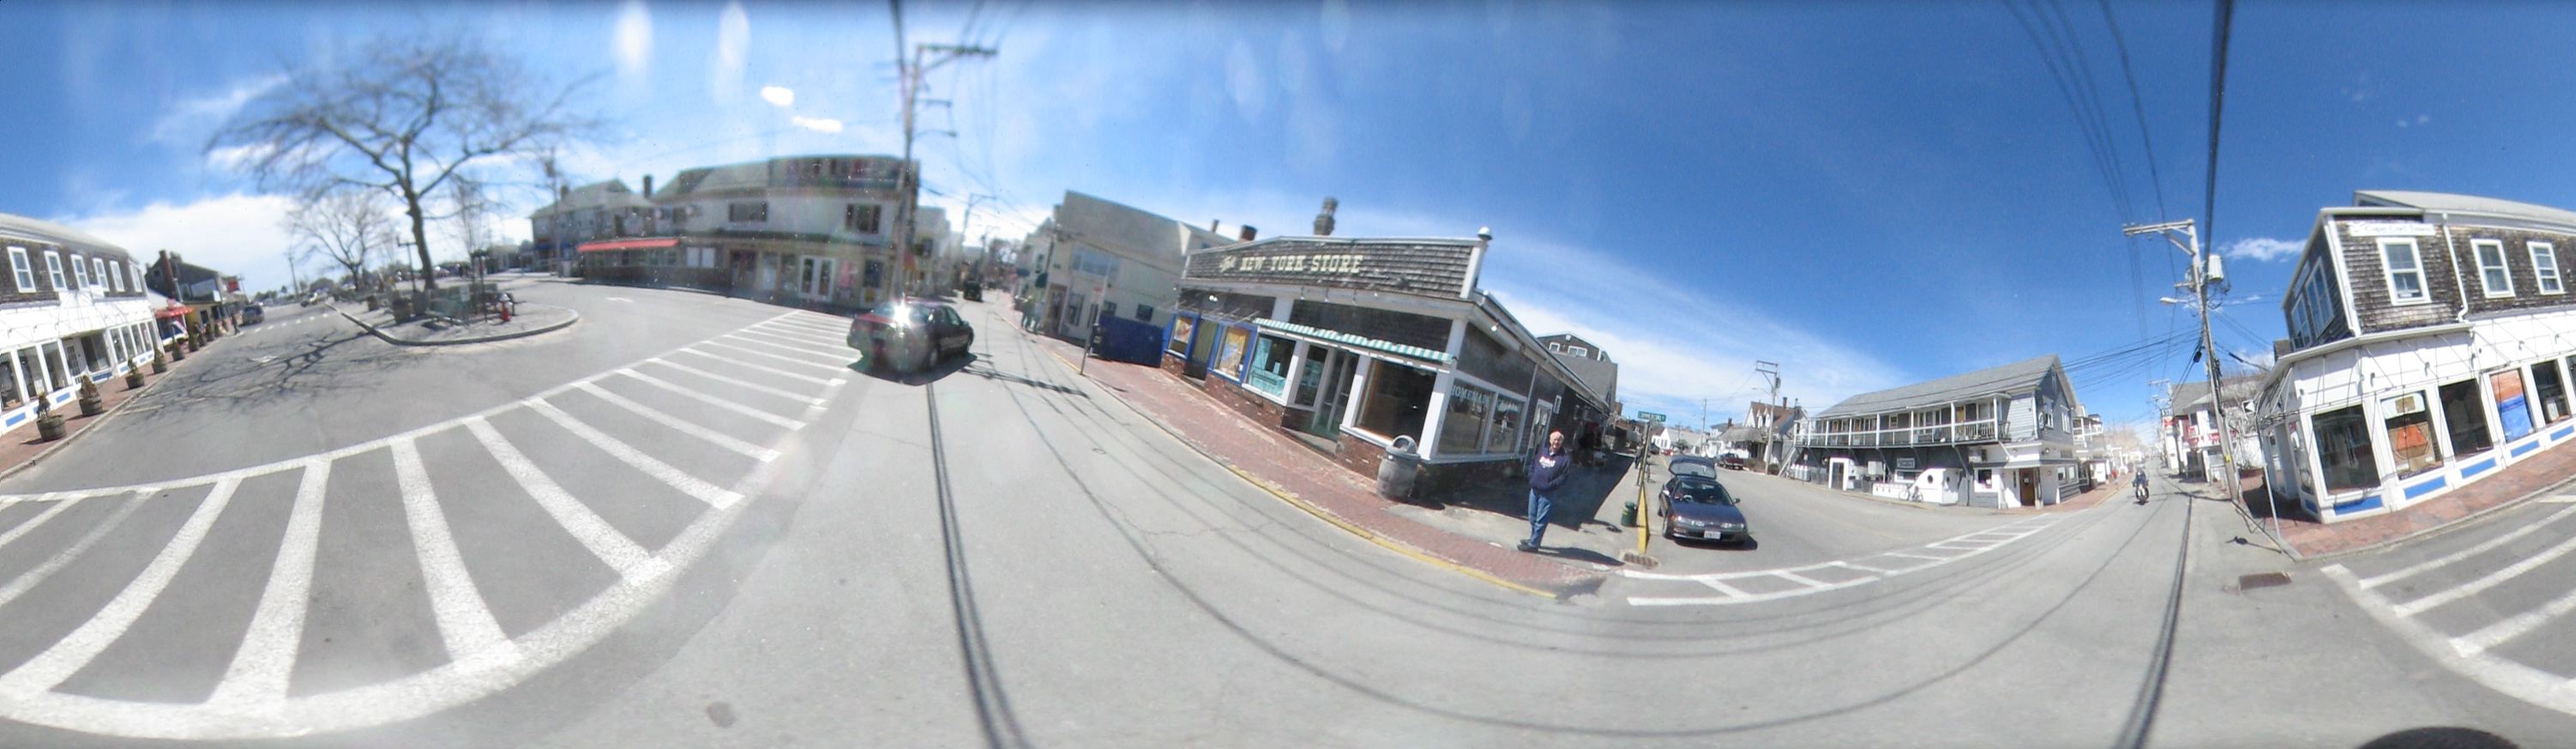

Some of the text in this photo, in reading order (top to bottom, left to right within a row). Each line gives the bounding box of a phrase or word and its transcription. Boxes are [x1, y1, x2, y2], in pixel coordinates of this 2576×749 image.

[1239, 257, 1266, 270] NEW
[1270, 256, 1306, 271] YORK
[1310, 255, 1363, 273] STORE
